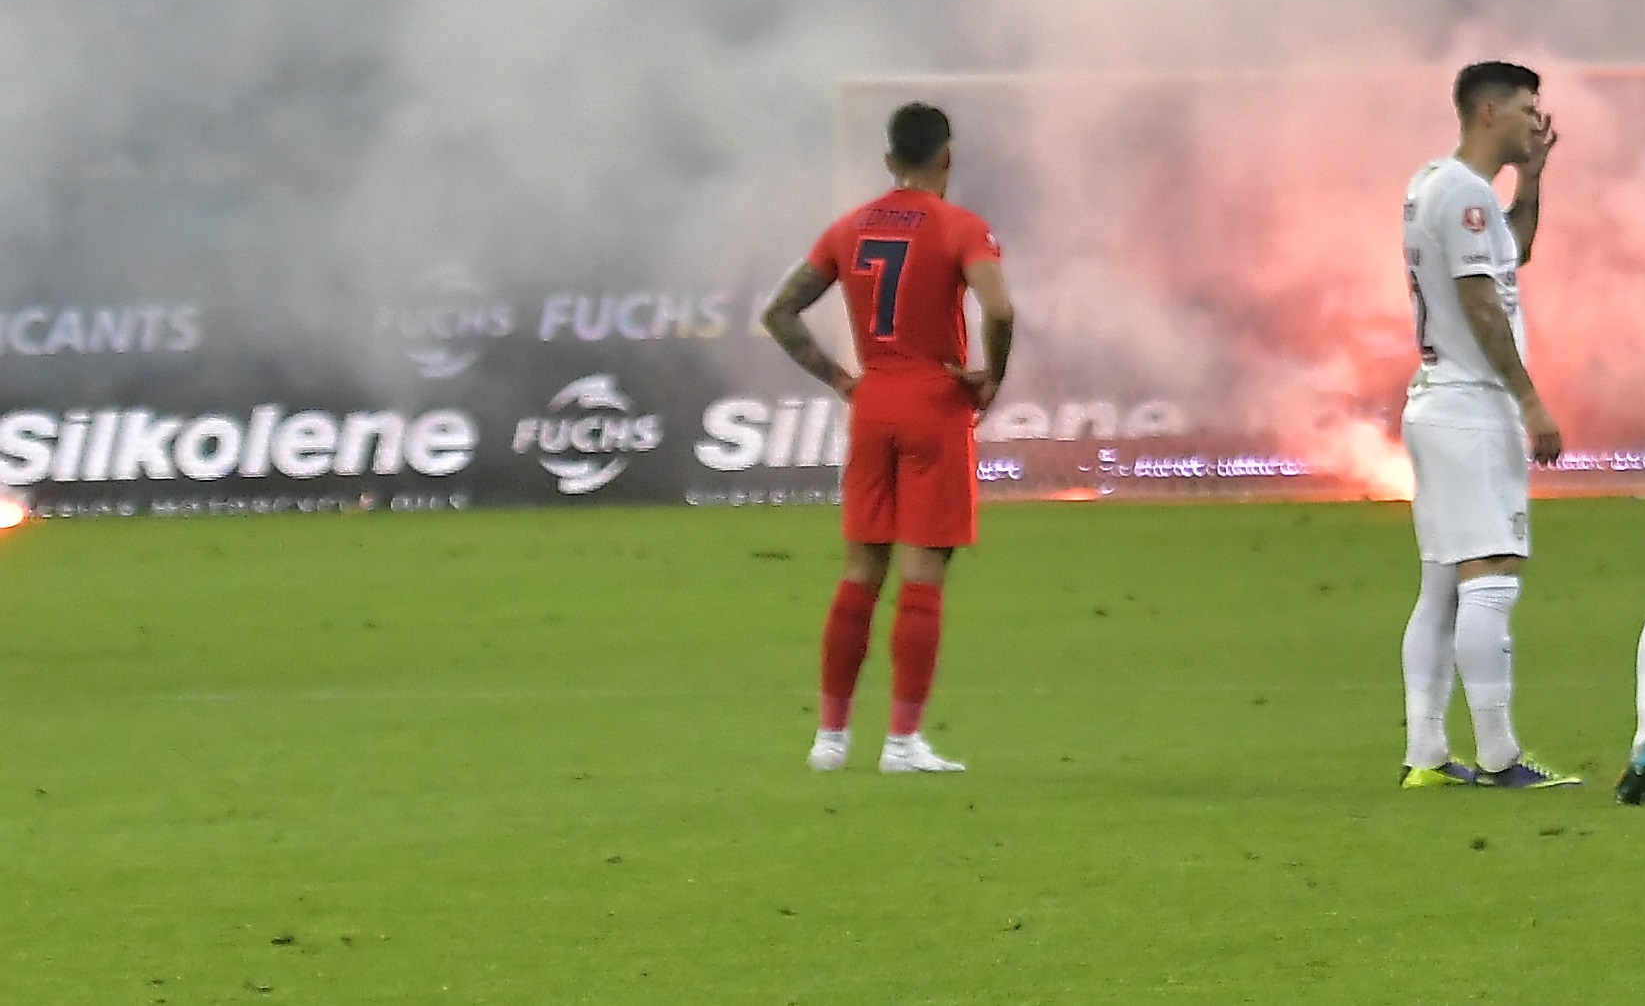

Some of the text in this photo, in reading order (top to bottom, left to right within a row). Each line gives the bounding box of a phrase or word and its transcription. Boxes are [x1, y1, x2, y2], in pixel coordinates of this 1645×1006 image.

[538, 290, 728, 342] FUCHS
[852, 235, 912, 340] 7
[0, 402, 478, 486] Silkolene
[511, 414, 664, 454] FUCHS
